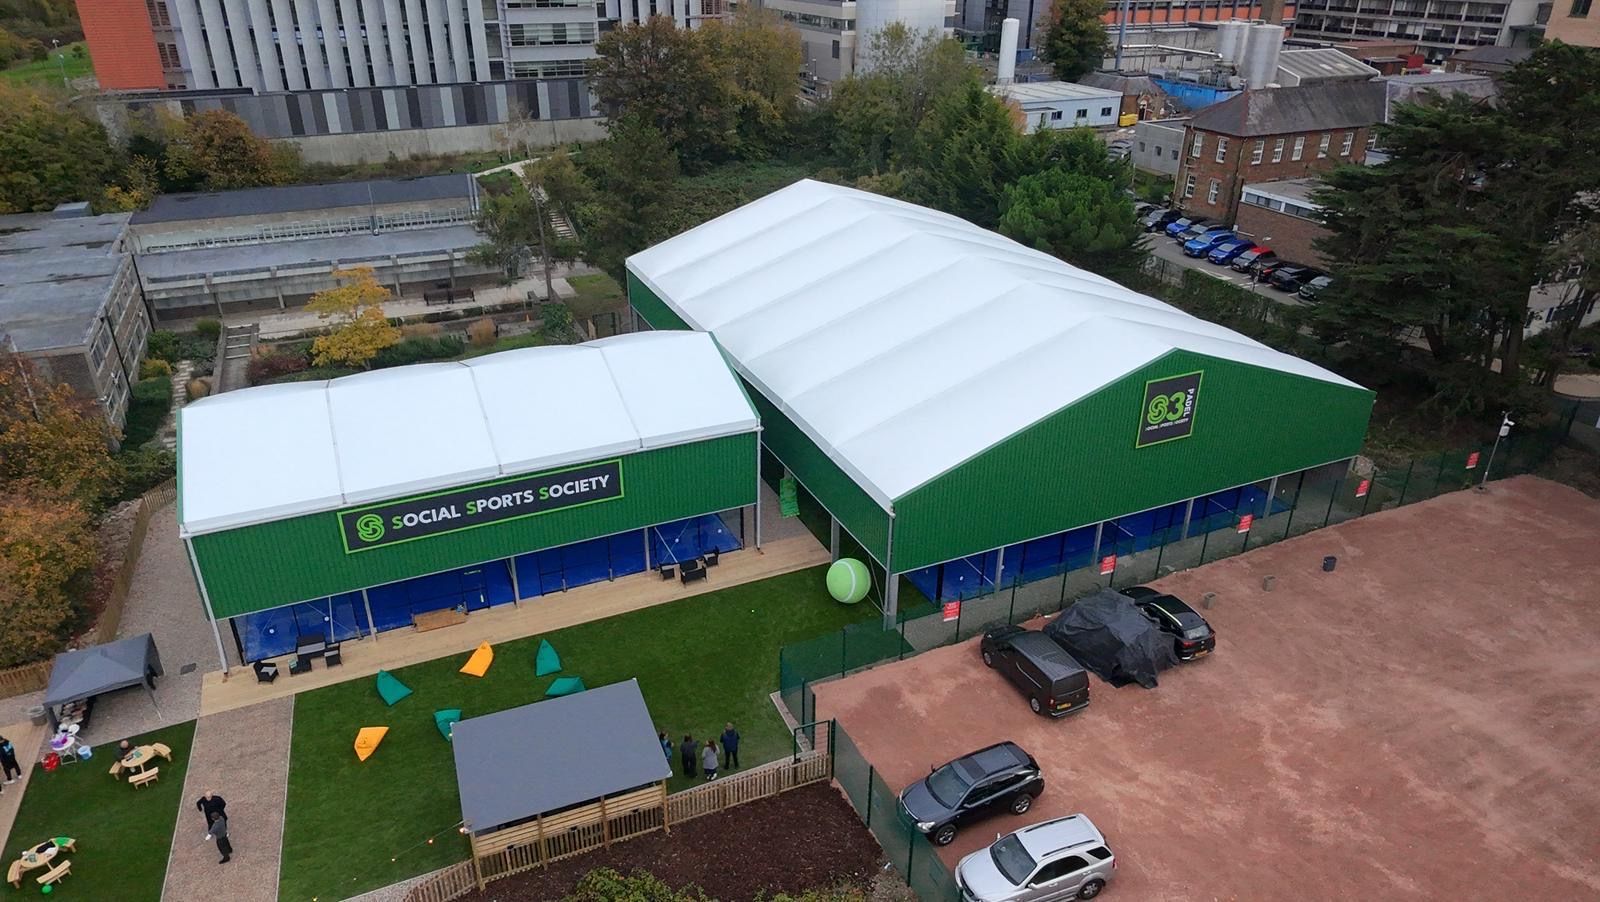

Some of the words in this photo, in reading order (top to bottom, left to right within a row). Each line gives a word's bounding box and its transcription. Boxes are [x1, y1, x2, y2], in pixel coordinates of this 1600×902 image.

[1183, 388, 1195, 417] PADEL
[392, 505, 461, 530] SOCIAL
[465, 490, 534, 515] SPORTS
[538, 474, 611, 501] SOCIETY
